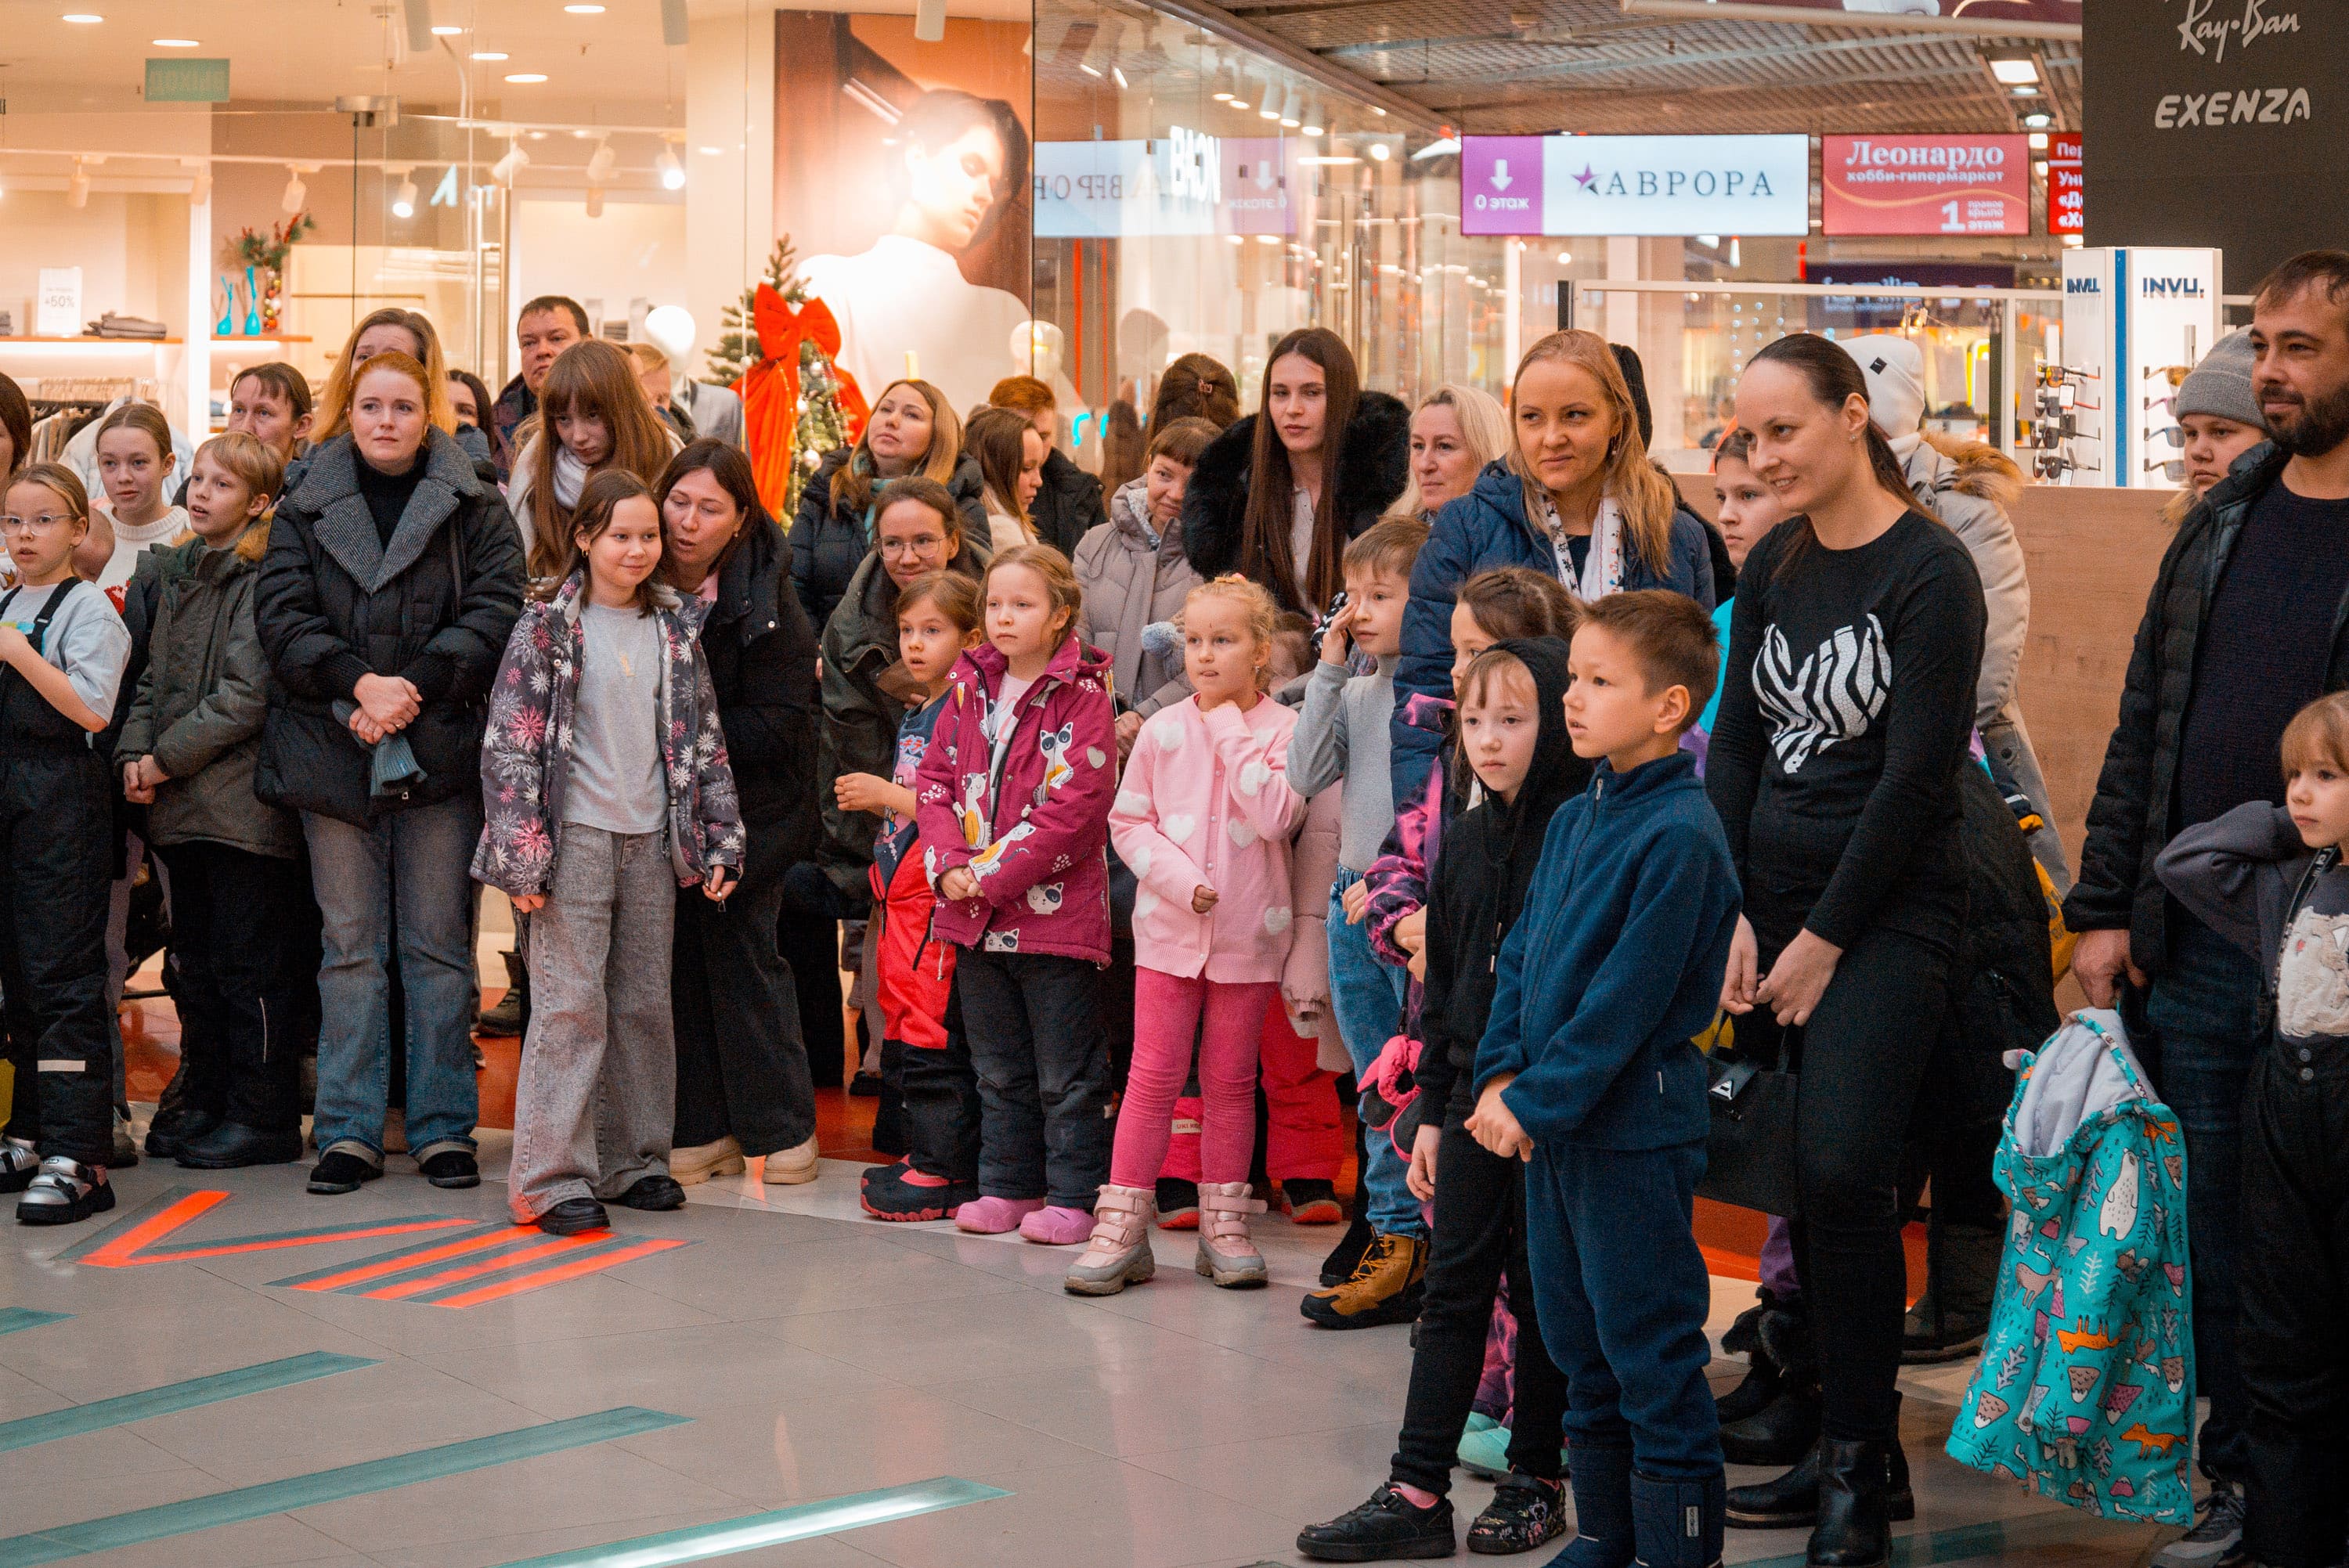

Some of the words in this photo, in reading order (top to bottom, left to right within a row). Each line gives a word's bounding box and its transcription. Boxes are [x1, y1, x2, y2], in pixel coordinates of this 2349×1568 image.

[2155, 87, 2310, 128] EXENZA
[1845, 141, 2004, 171] Леонардо
[1605, 170, 1774, 196] АВРОРА
[1846, 169, 2004, 184] хобби-гипермаркет
[1474, 194, 1486, 210] 0
[1489, 197, 1530, 210] этаж
[1941, 200, 1966, 232] 1
[1967, 220, 2005, 231] этаж
